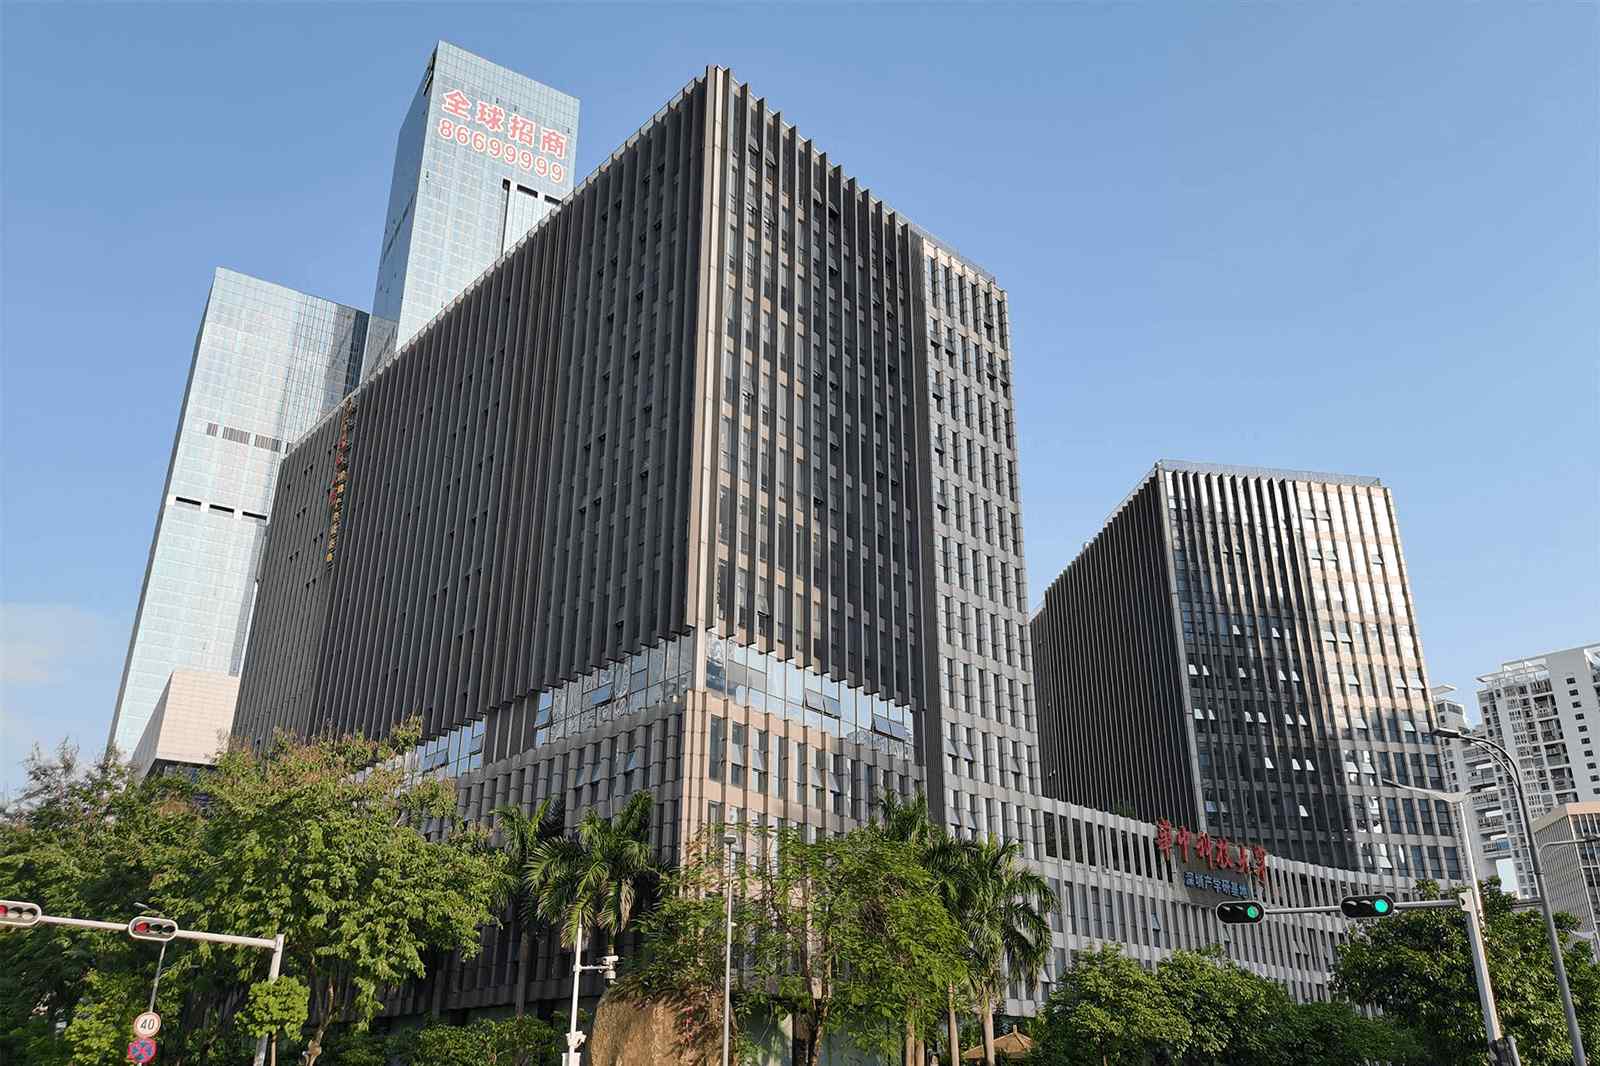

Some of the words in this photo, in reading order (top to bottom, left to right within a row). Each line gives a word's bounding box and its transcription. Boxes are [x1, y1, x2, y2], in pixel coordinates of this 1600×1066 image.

[438, 118, 565, 183] 86699999
[442, 90, 568, 160] 全球招商
[140, 1019, 155, 1030] 40
